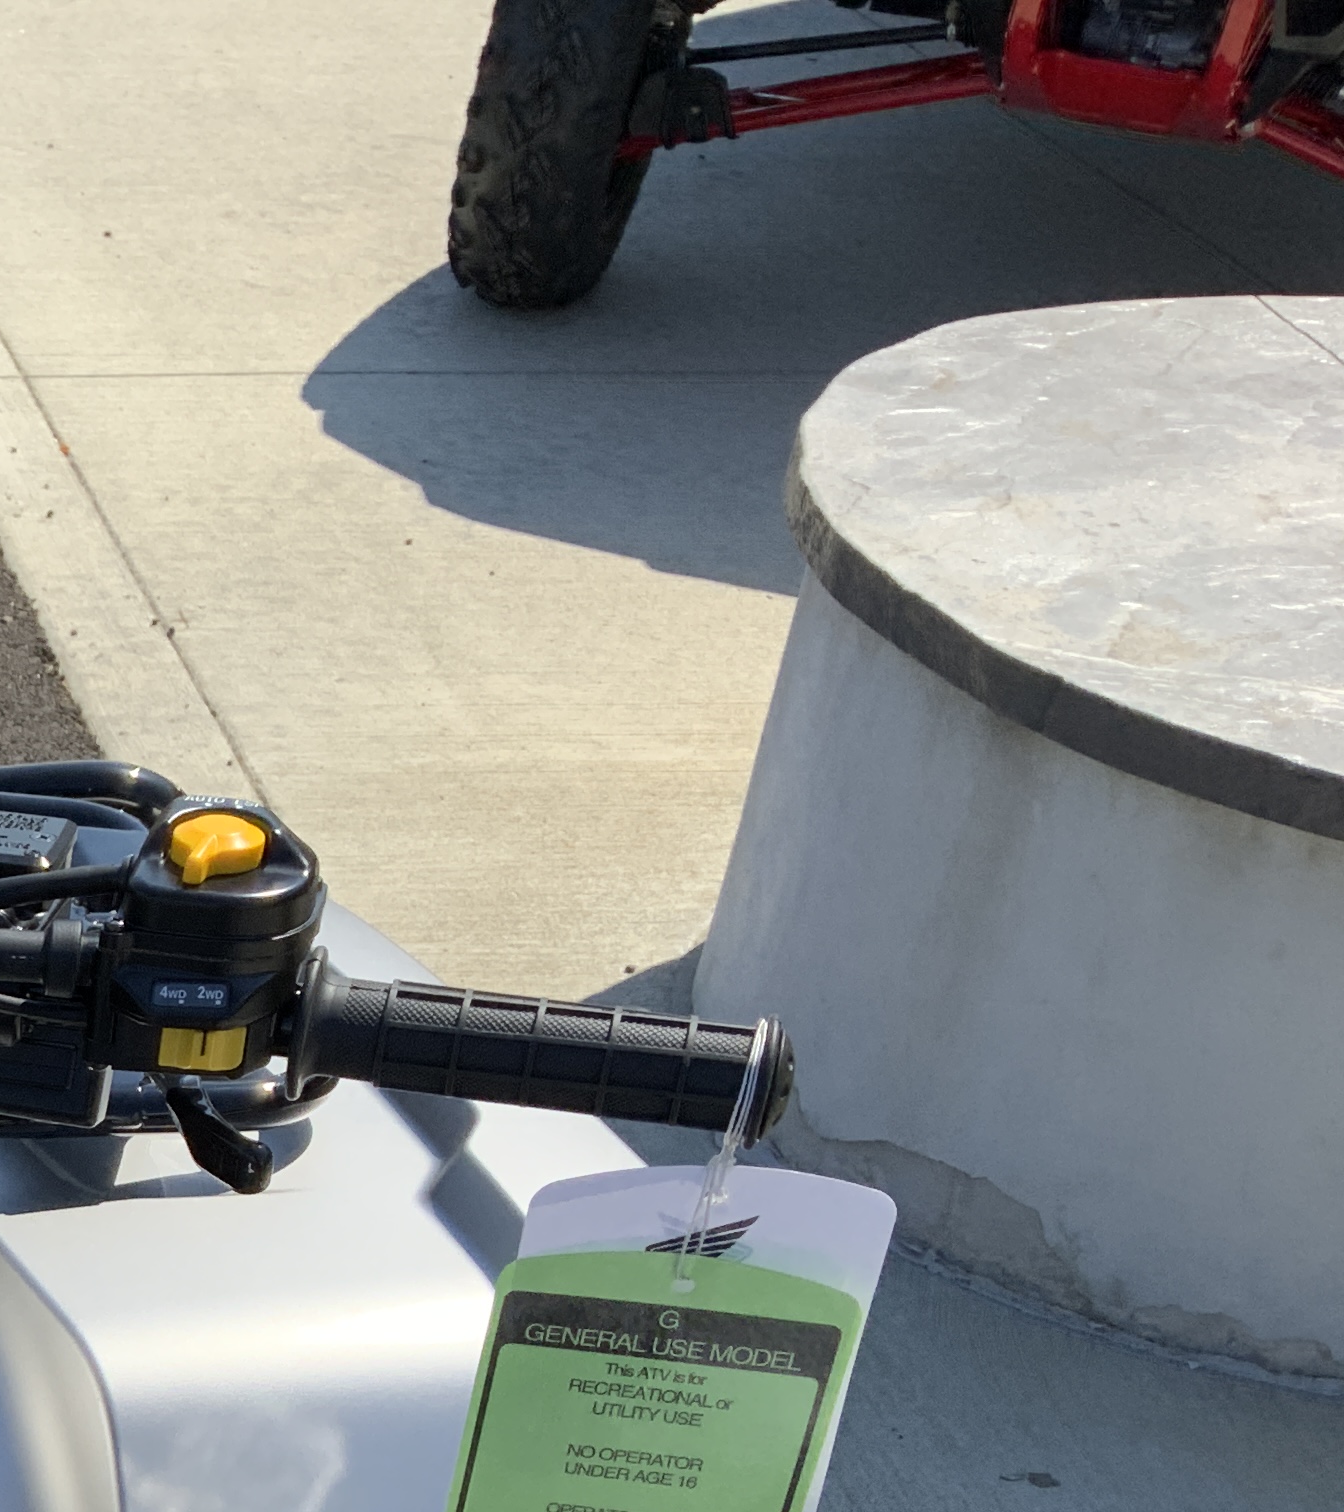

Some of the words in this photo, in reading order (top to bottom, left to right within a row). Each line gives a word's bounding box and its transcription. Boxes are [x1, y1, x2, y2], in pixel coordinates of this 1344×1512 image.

[160, 986, 187, 998] 4WD
[197, 986, 223, 999] 2WD
[659, 1311, 679, 1330] G
[525, 1323, 645, 1352] GENERAL
[653, 1337, 702, 1359] USE
[712, 1343, 802, 1370] MODEL
[604, 1362, 634, 1376] This
[638, 1366, 669, 1380] ATV
[674, 1370, 685, 1382] is
[689, 1372, 707, 1384] for
[569, 1378, 713, 1407] RECREATIONAL
[717, 1398, 733, 1409] or
[593, 1402, 658, 1420] UTILITY
[664, 1410, 702, 1426] USE
[568, 1443, 594, 1458] NO
[599, 1446, 702, 1470] OPERATOR
[564, 1462, 628, 1480] UNDER
[634, 1469, 672, 1485] AGE
[679, 1474, 697, 1488] 16
